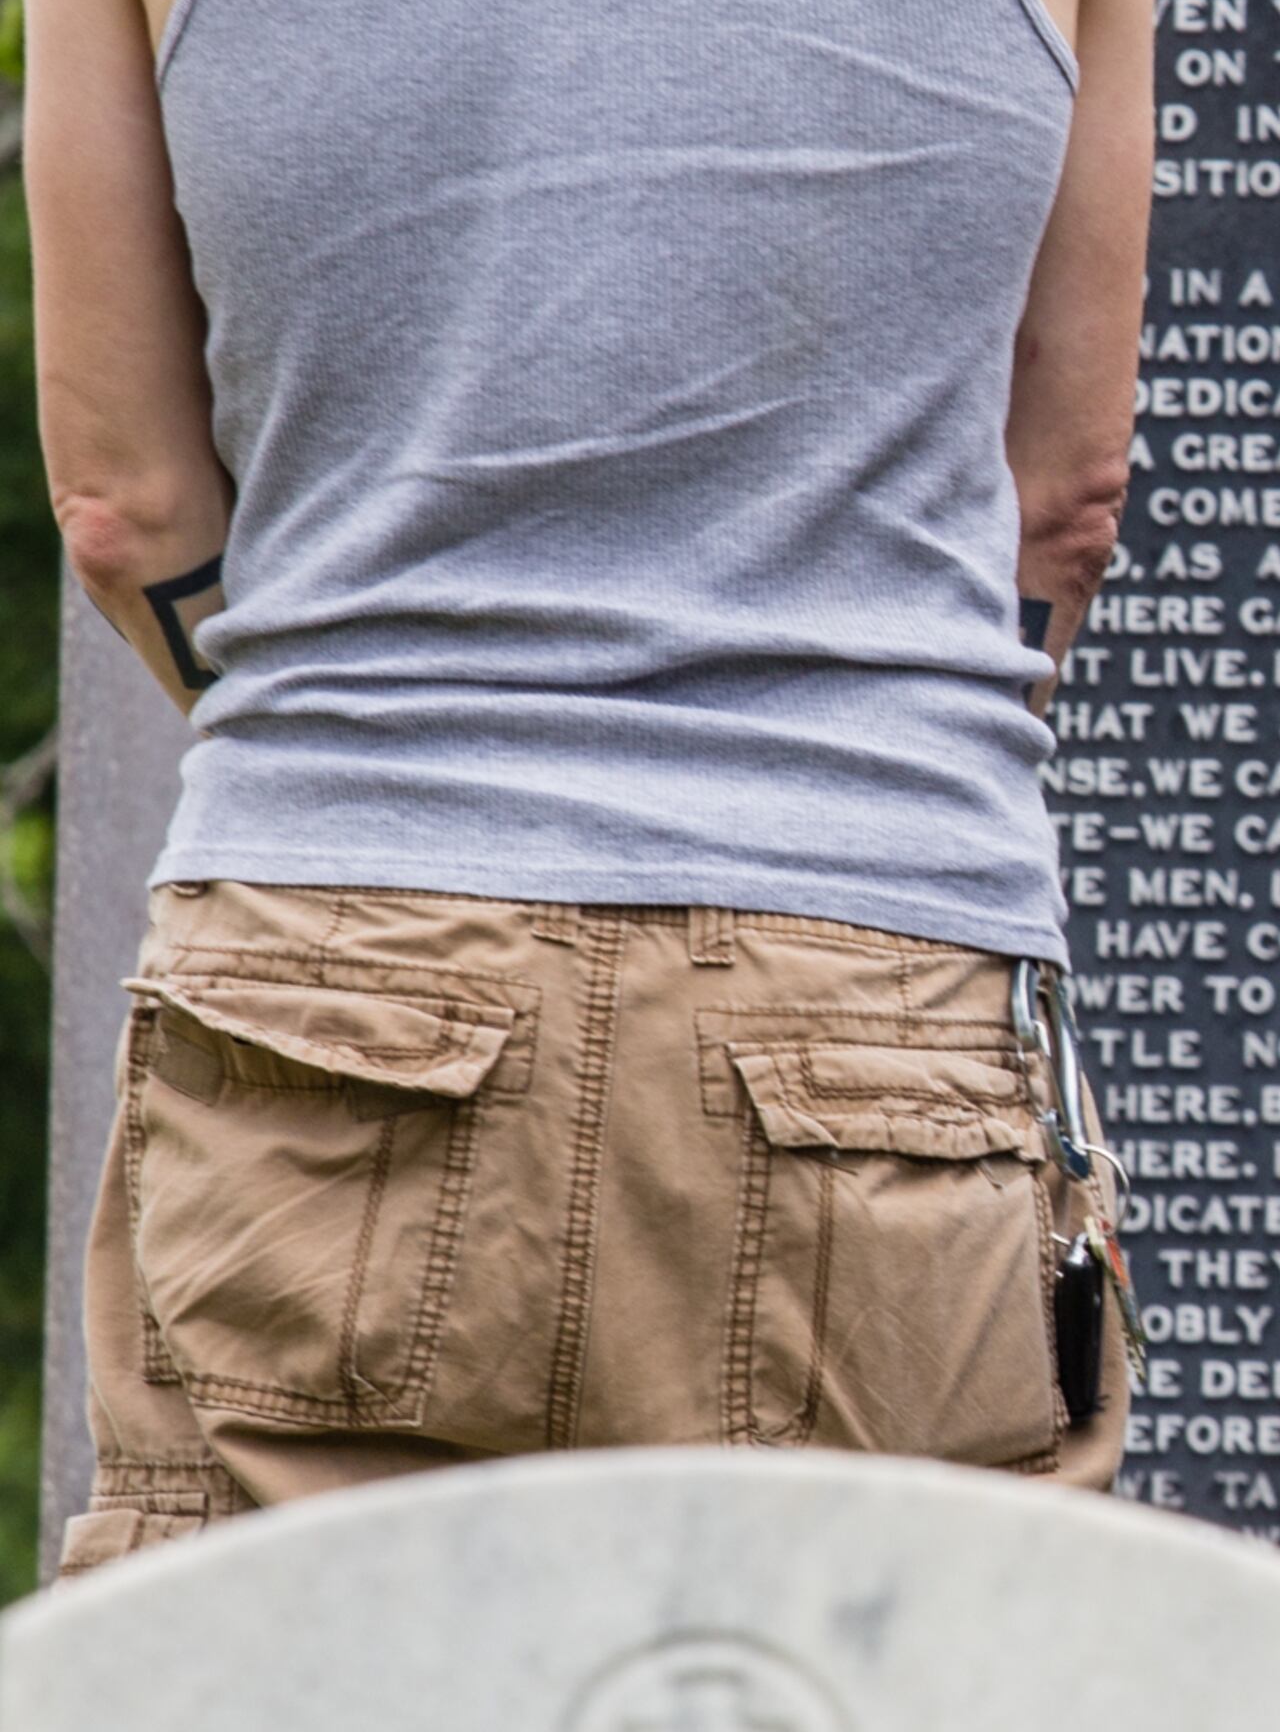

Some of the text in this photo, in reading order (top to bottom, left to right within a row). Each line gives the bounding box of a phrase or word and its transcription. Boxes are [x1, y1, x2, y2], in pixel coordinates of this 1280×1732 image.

[1175, 49, 1246, 86] ON
[1160, 103, 1198, 143] D
[1170, 268, 1221, 307] IN
[1238, 269, 1274, 307] A
[1126, 433, 1154, 470] A
[1156, 543, 1223, 581] AS
[1088, 594, 1225, 635] HERE
[1046, 701, 1154, 742] HAT
[1180, 702, 1258, 743] WE
[1060, 866, 1106, 906] E
[1097, 920, 1227, 960] HAVE
[1204, 974, 1276, 1014] TO
[1077, 1028, 1201, 1068] TLE
[1141, 1303, 1273, 1345] OBLY
